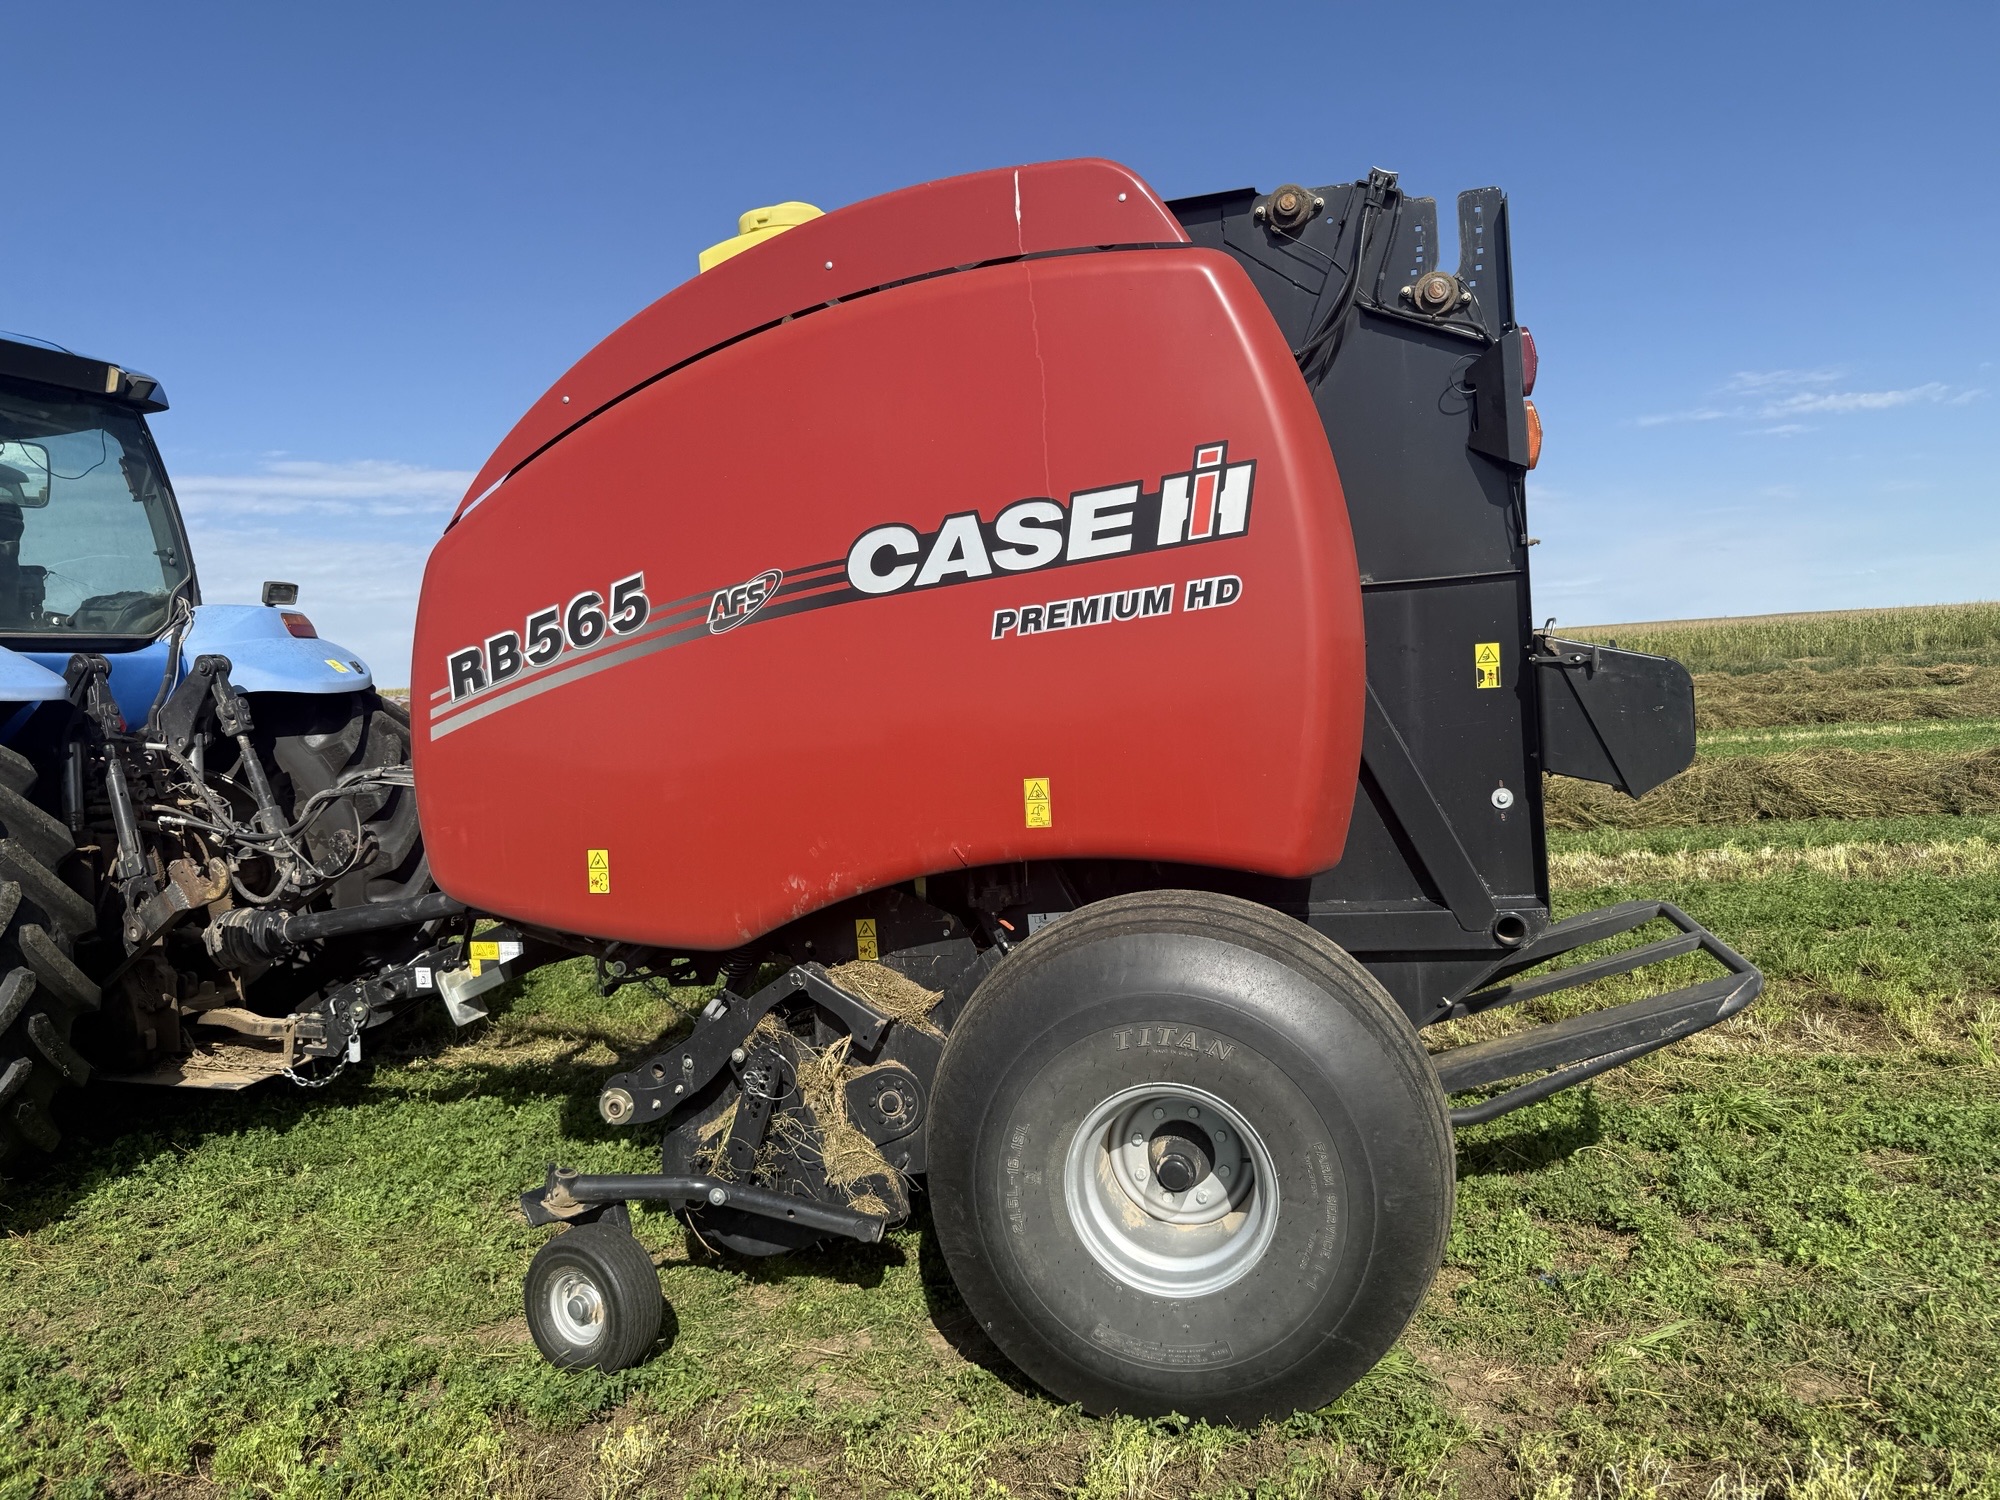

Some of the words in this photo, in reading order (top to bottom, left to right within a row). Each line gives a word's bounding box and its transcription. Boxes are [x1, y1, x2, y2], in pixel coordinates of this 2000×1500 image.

[847, 485, 1138, 594] CASE
[706, 575, 770, 625] AFS
[992, 584, 1174, 639] PREMIUM
[1184, 575, 1242, 611] HD
[447, 571, 650, 703] RB565
[1112, 1026, 1236, 1060] TITAN
[1312, 1142, 1335, 1187] FARM
[1320, 1193, 1338, 1259] SERVICE
